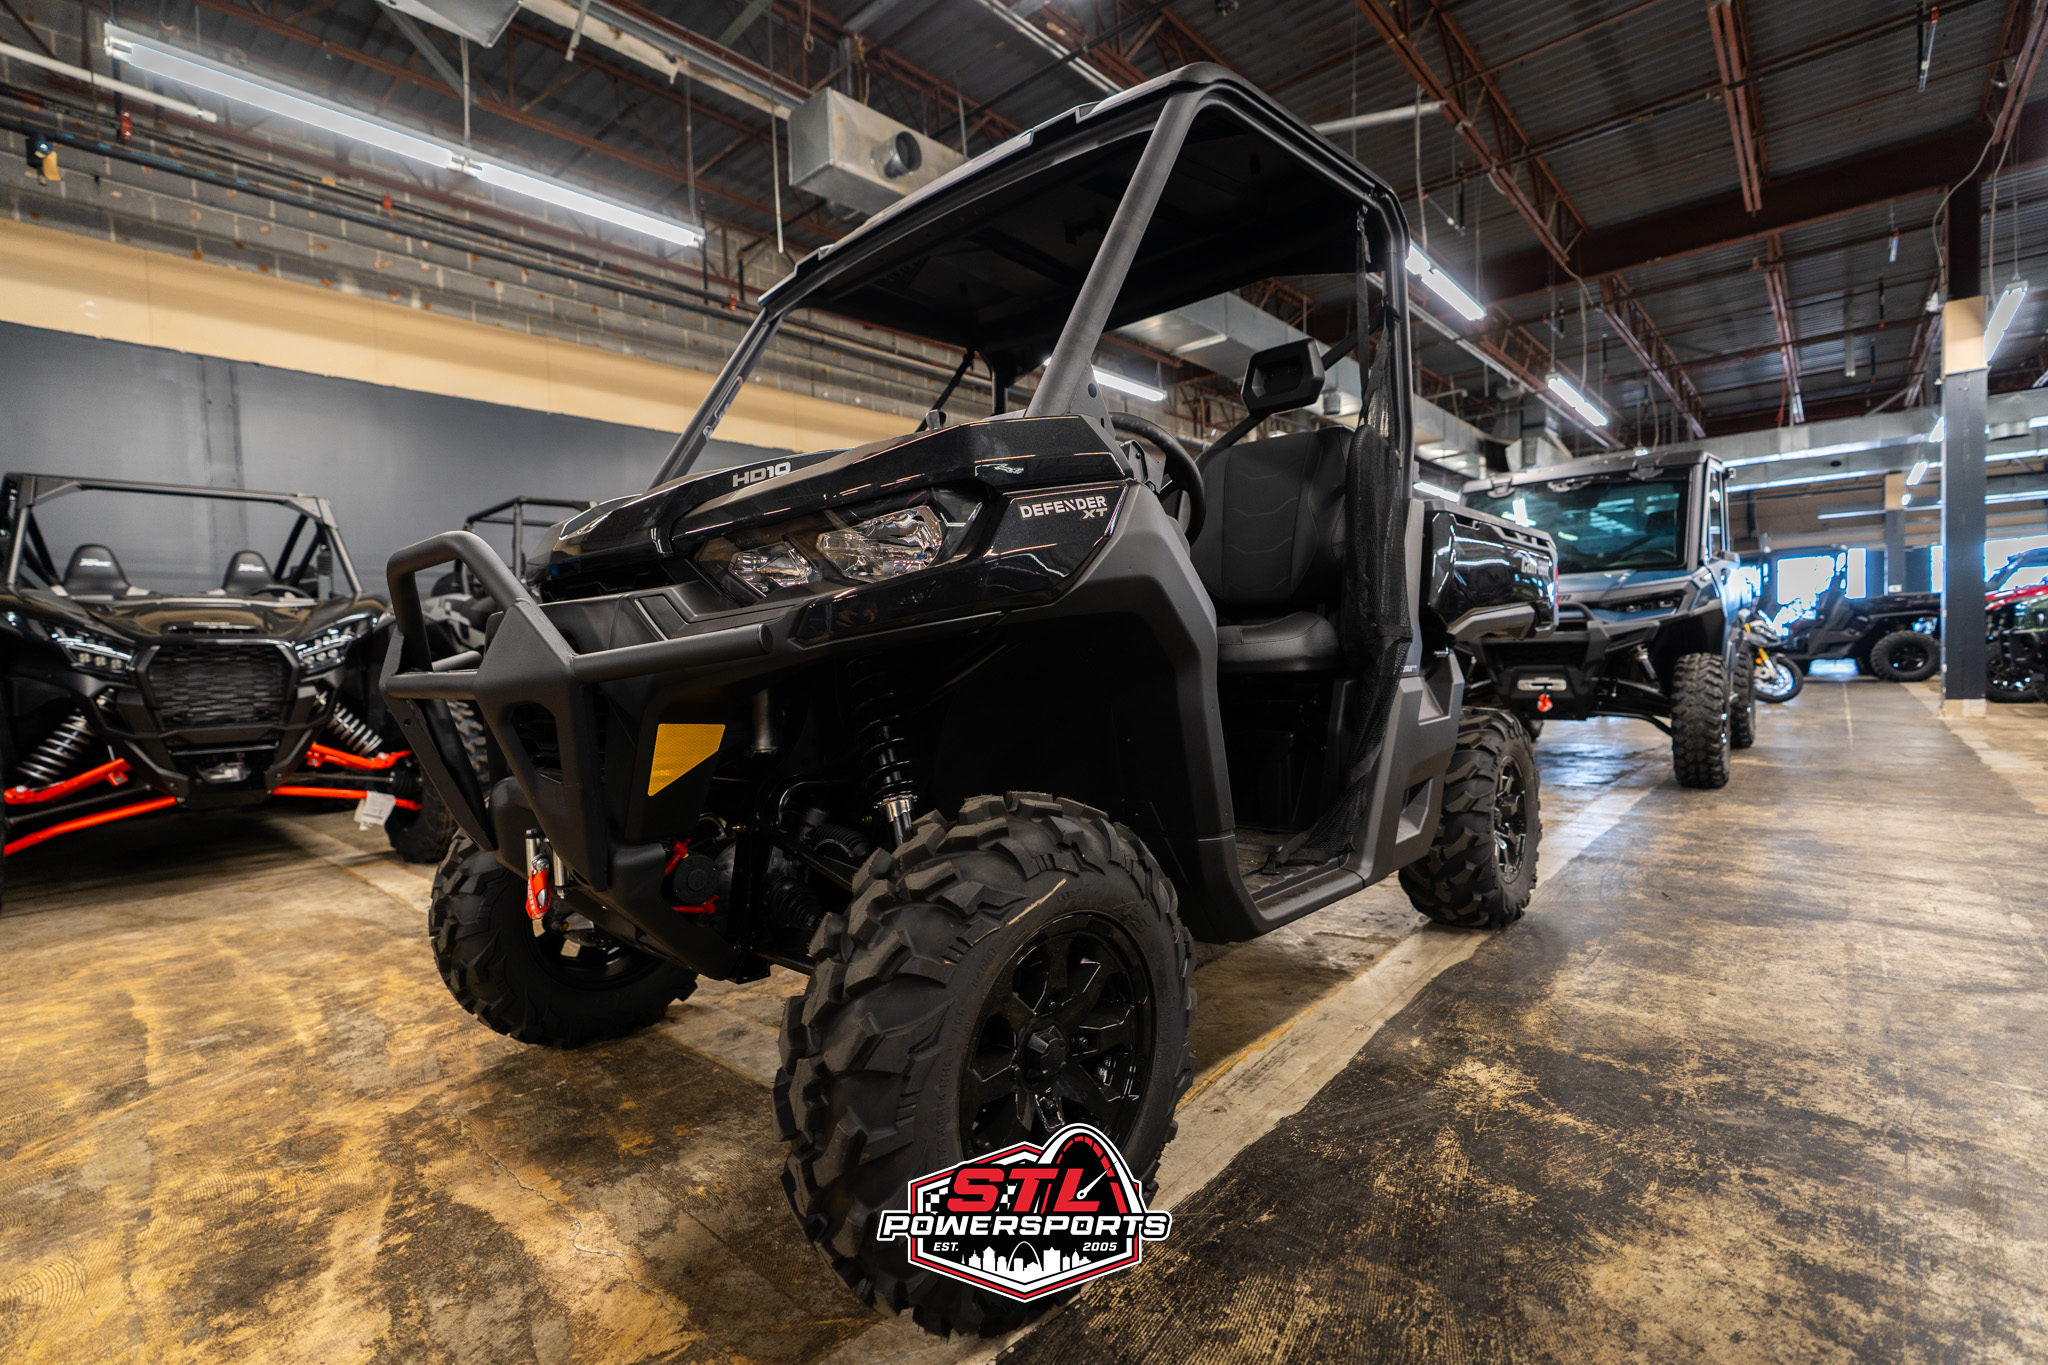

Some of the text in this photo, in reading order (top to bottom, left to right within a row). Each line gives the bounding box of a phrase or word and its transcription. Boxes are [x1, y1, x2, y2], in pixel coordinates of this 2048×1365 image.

[733, 461, 791, 487] HD10
[1020, 496, 1107, 518] DEFENDER
[1082, 507, 1108, 519] XT
